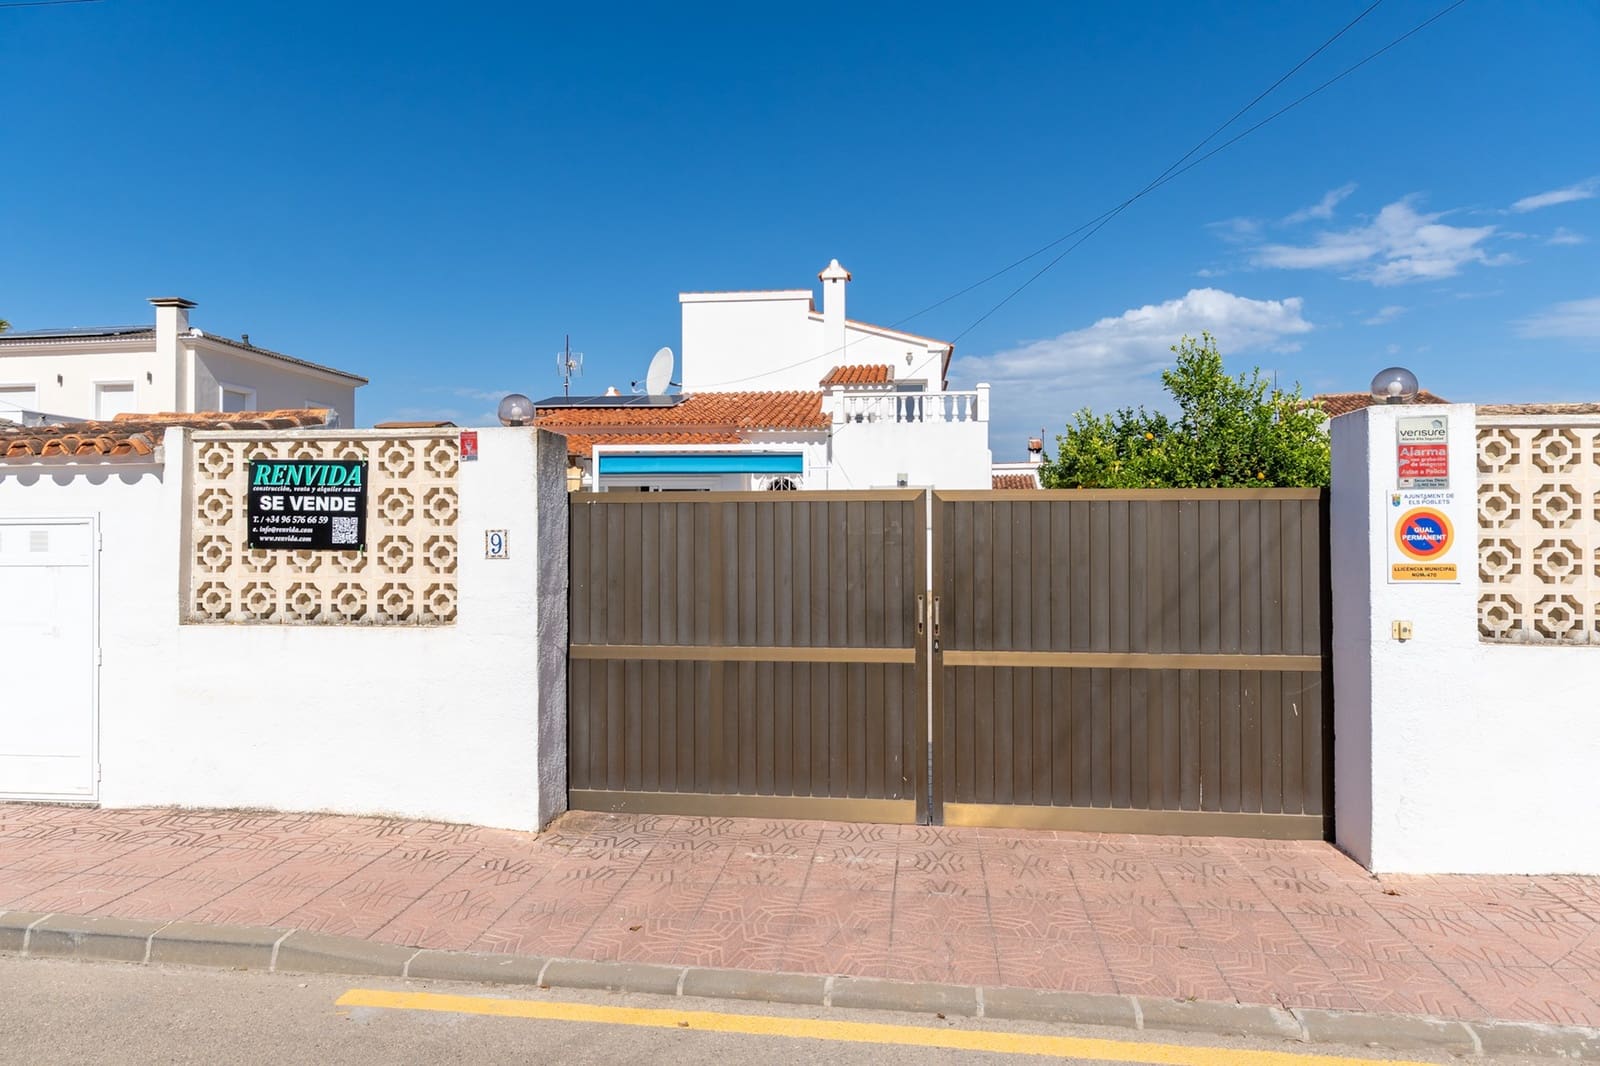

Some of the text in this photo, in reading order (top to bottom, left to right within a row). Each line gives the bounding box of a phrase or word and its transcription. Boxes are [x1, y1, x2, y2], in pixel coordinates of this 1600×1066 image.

[1400, 429, 1446, 437] verisure
[1400, 447, 1446, 456] Alarma
[253, 464, 362, 486] RENVIDA
[260, 495, 356, 512] SE VENDE
[265, 515, 280, 524] +34
[281, 515, 291, 524] 96
[292, 515, 306, 524] 576
[307, 516, 317, 524] 66
[318, 516, 329, 524] 59
[260, 525, 313, 534] info@renvida.com
[491, 533, 502, 554] 9
